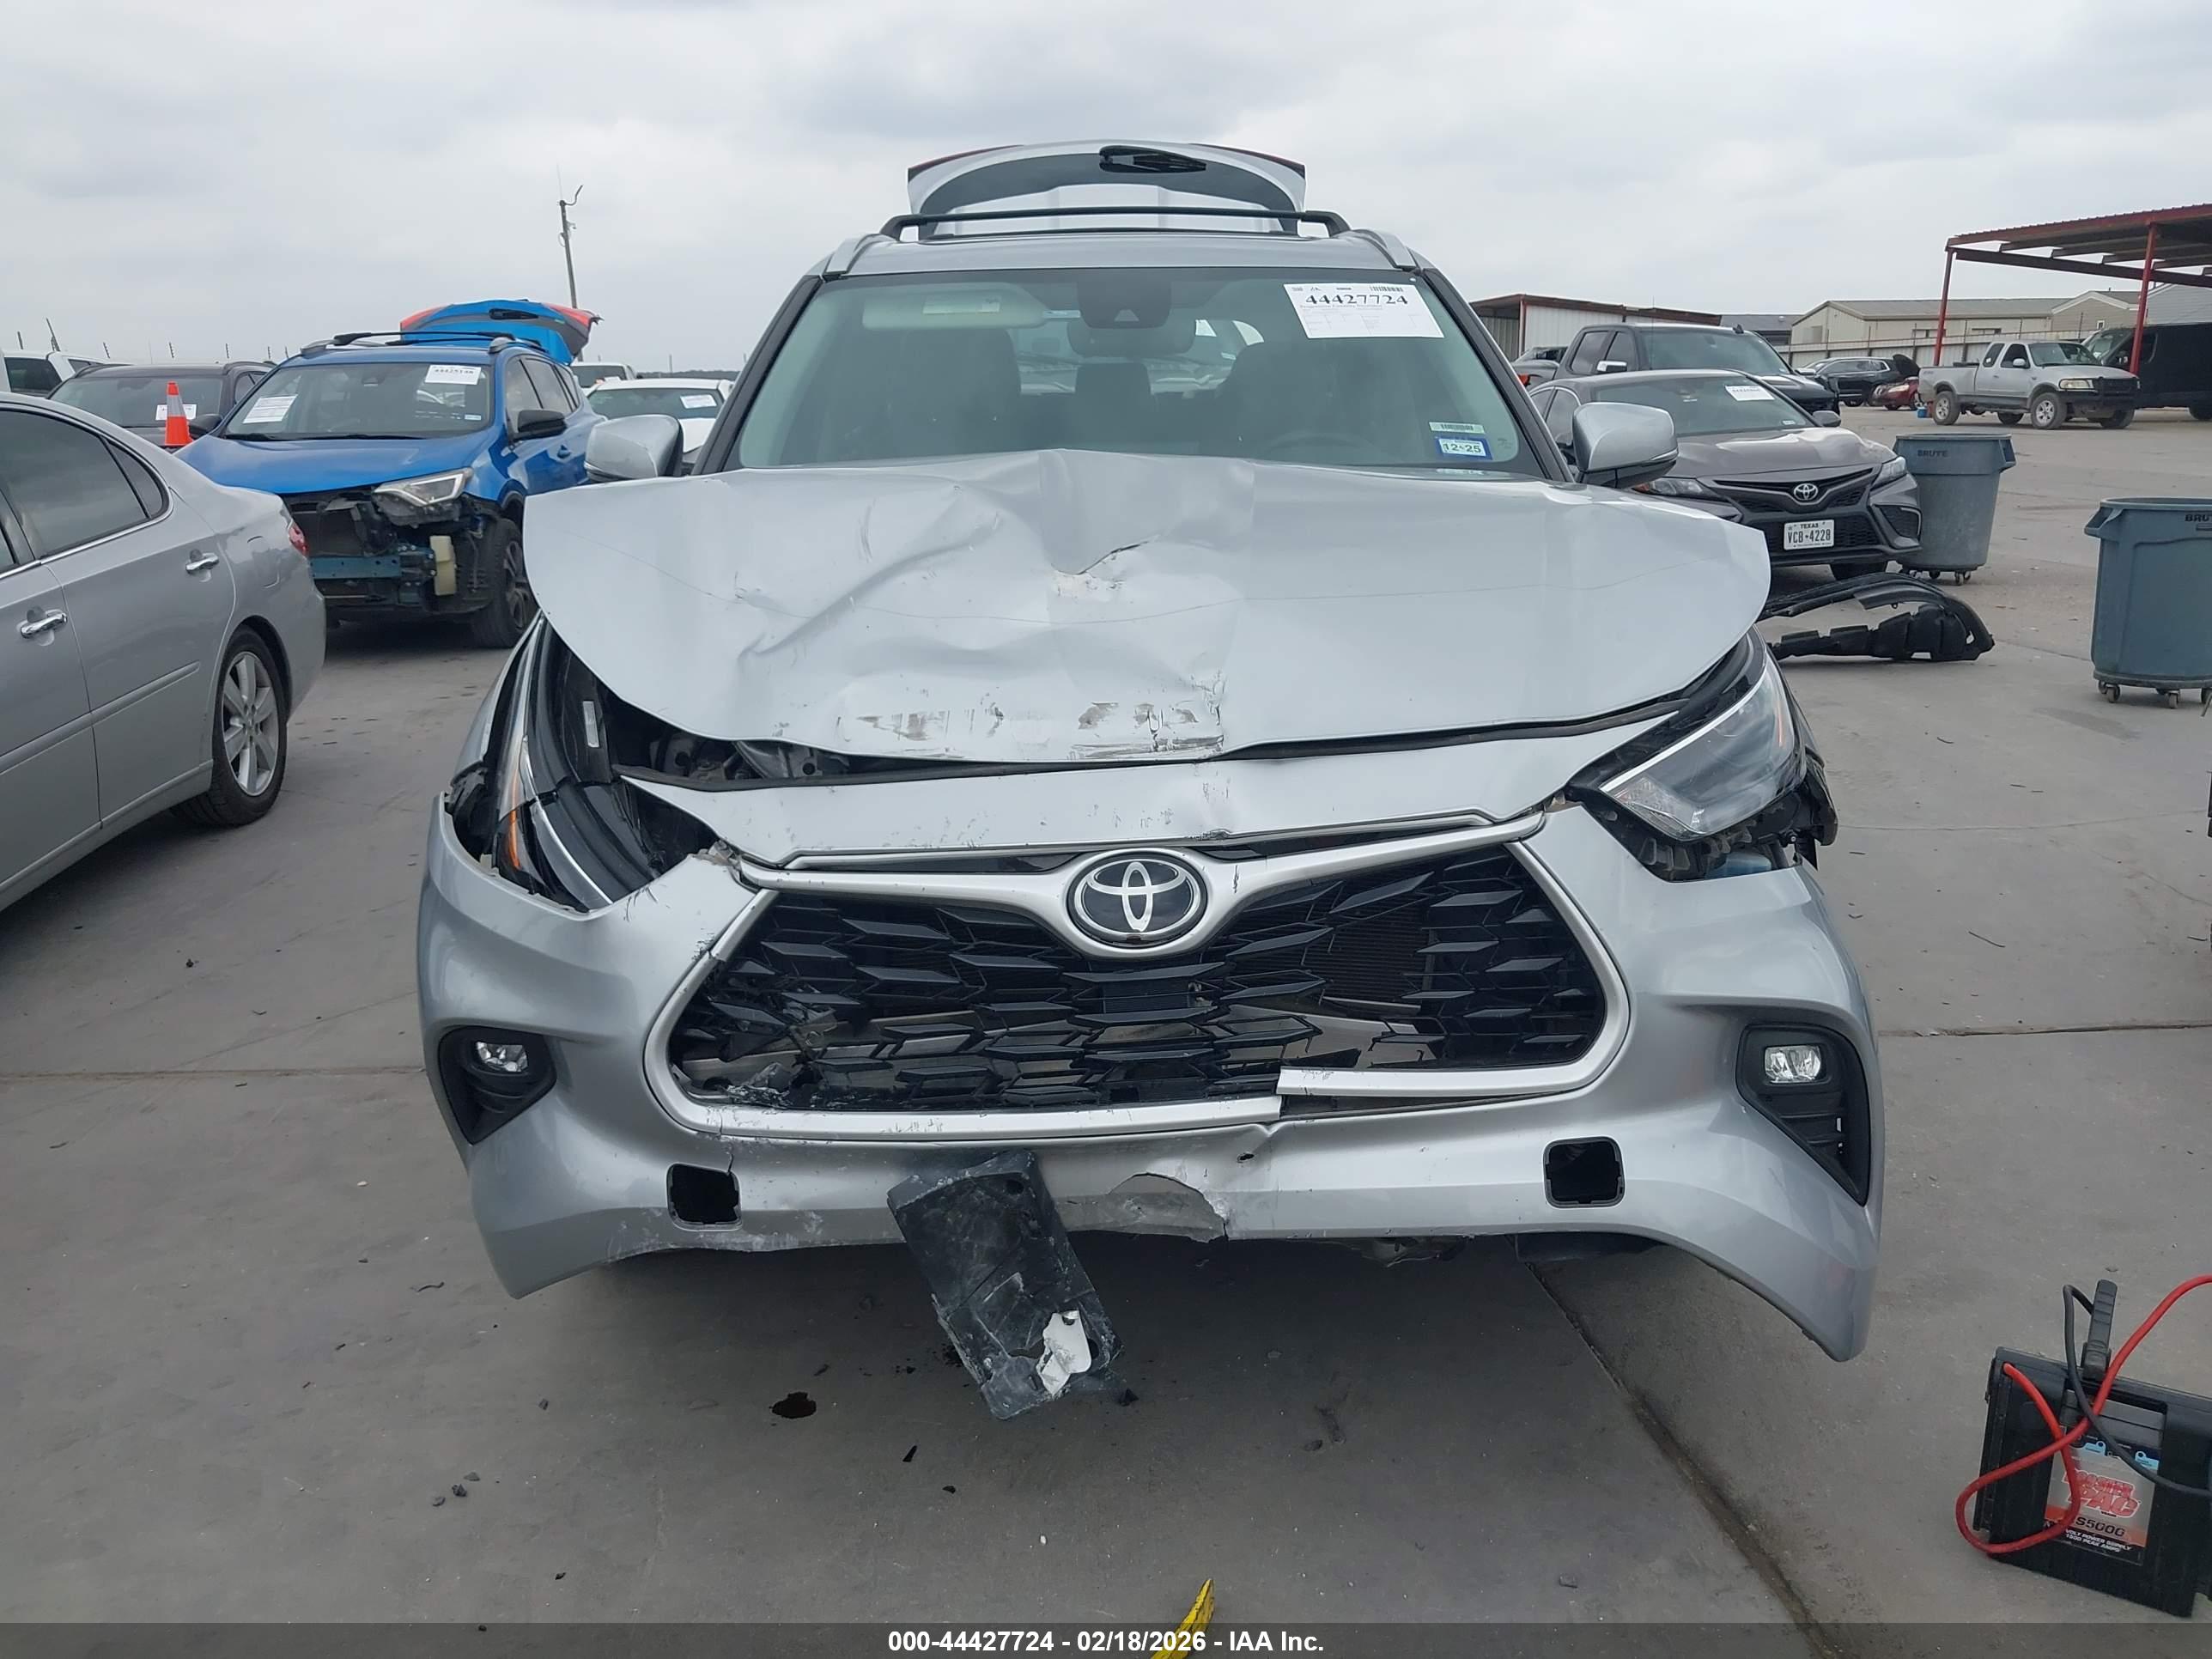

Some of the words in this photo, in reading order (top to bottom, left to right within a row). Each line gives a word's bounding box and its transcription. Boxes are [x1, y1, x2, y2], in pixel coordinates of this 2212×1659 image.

[1305, 295, 1408, 305] 44427724
[1443, 443, 1459, 452] 12
[1466, 444, 1482, 453] 25
[1917, 449, 1948, 458] BRUTE
[2062, 1469, 2134, 1498] OOSTER
[2081, 1534, 2106, 1544] POWER
[2106, 1540, 2132, 1551] SUPPLY
[2082, 1537, 2100, 1547] PEAK
[2100, 1543, 2121, 1553] AMPS
